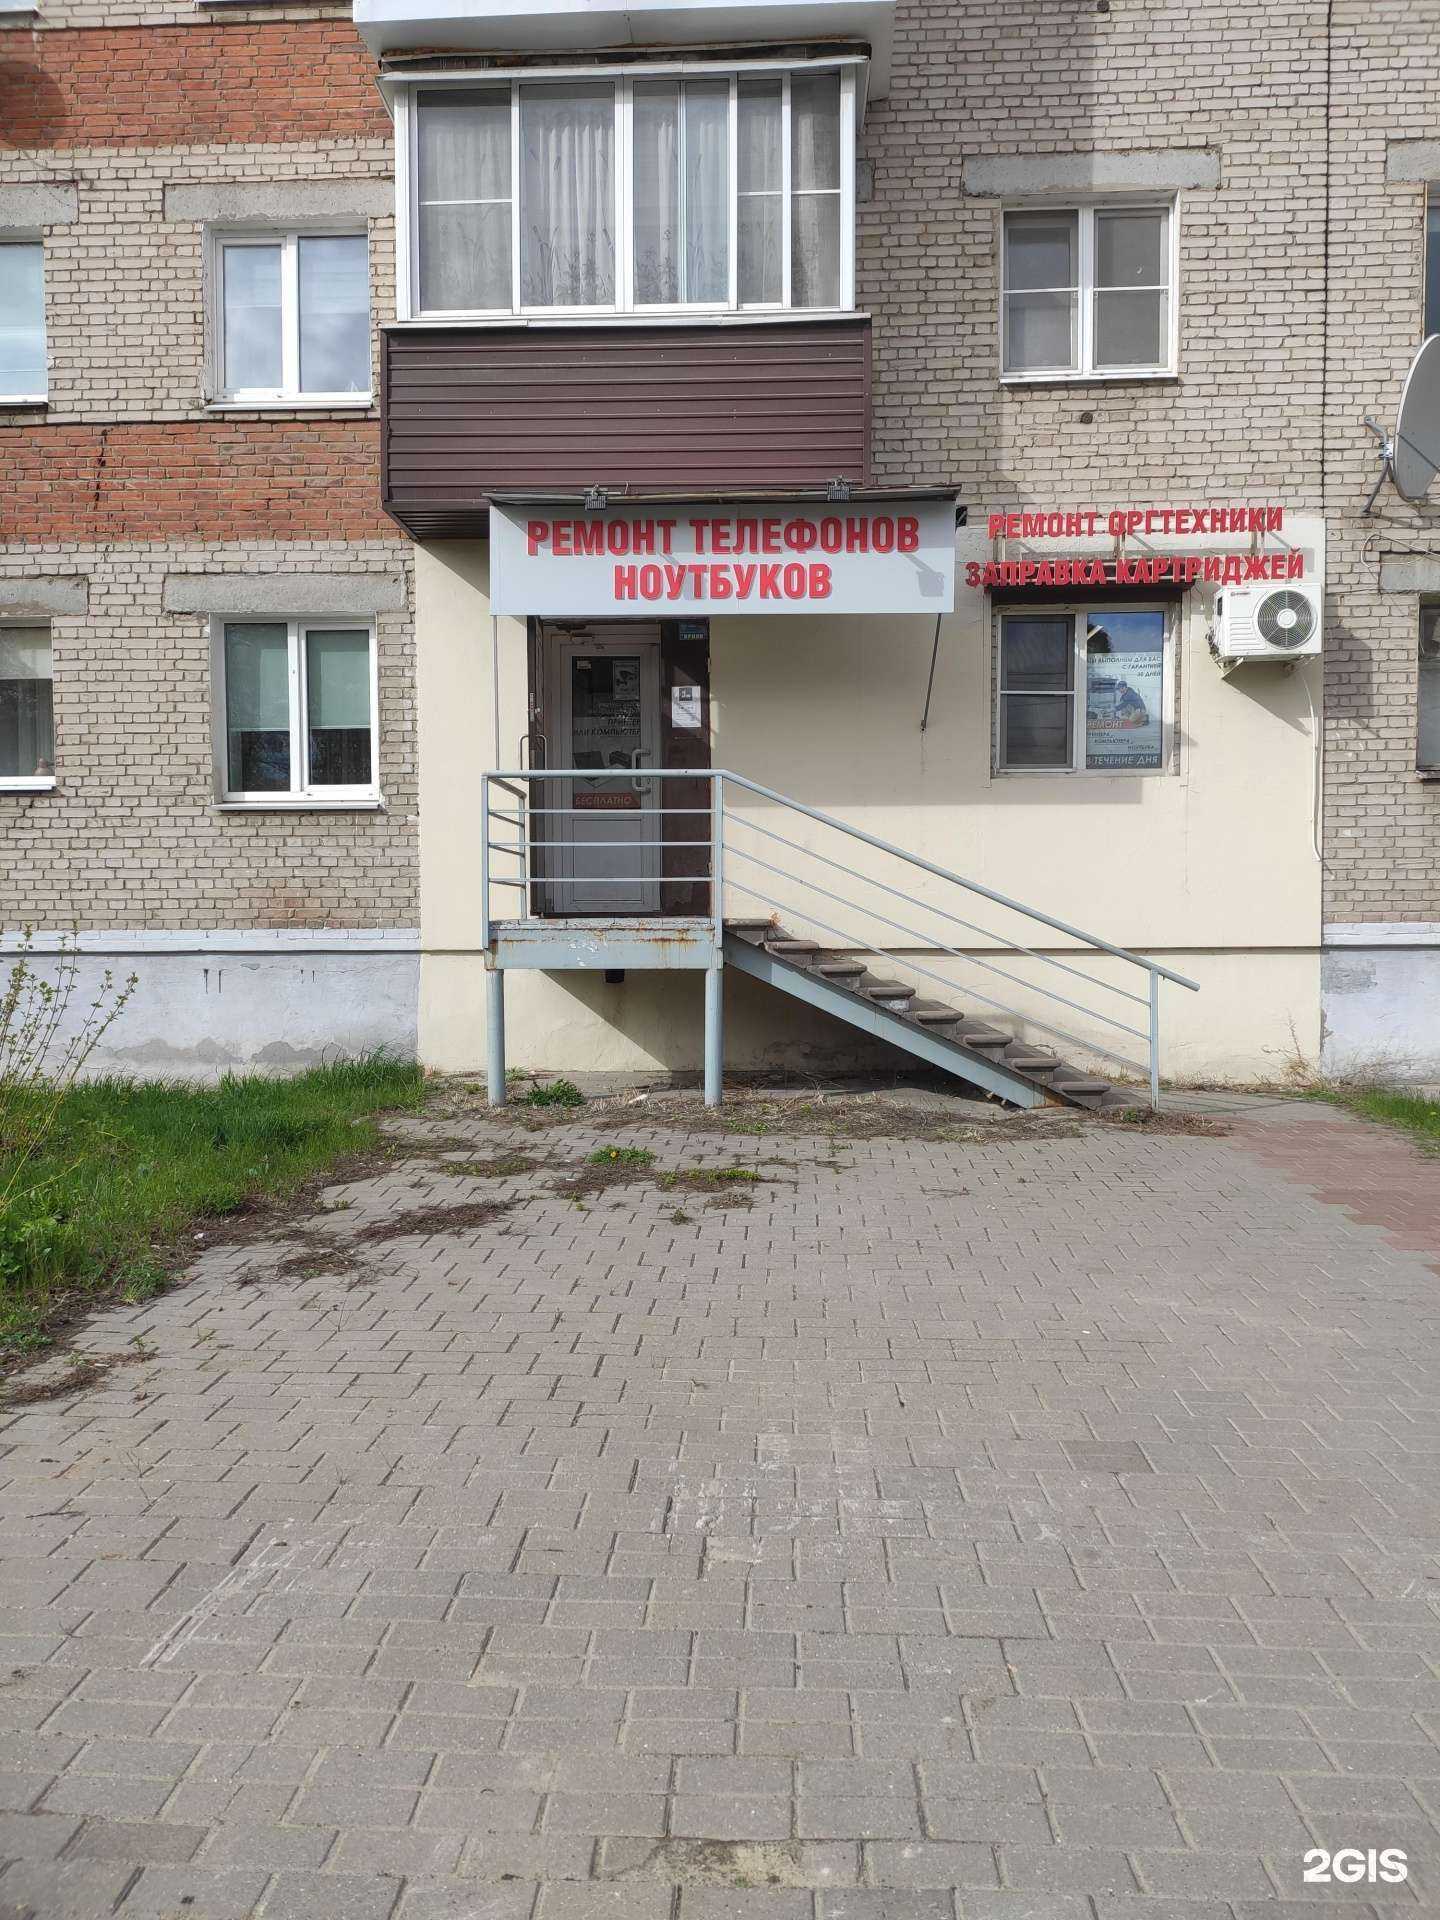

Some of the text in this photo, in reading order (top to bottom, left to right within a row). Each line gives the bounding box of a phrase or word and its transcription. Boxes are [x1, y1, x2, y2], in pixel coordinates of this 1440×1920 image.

[527, 515, 920, 556] РЕМОНТ ТЕЛЕФОНОВ
[988, 507, 1283, 540] РЕМОНТ ОРГТЕХНИКИ
[614, 563, 832, 600] НОУТБУКОВ
[965, 545, 1304, 587] ЗАПРАВКА КАРТРИДЖЕЙ
[1137, 756, 1159, 766] ДНЯ
